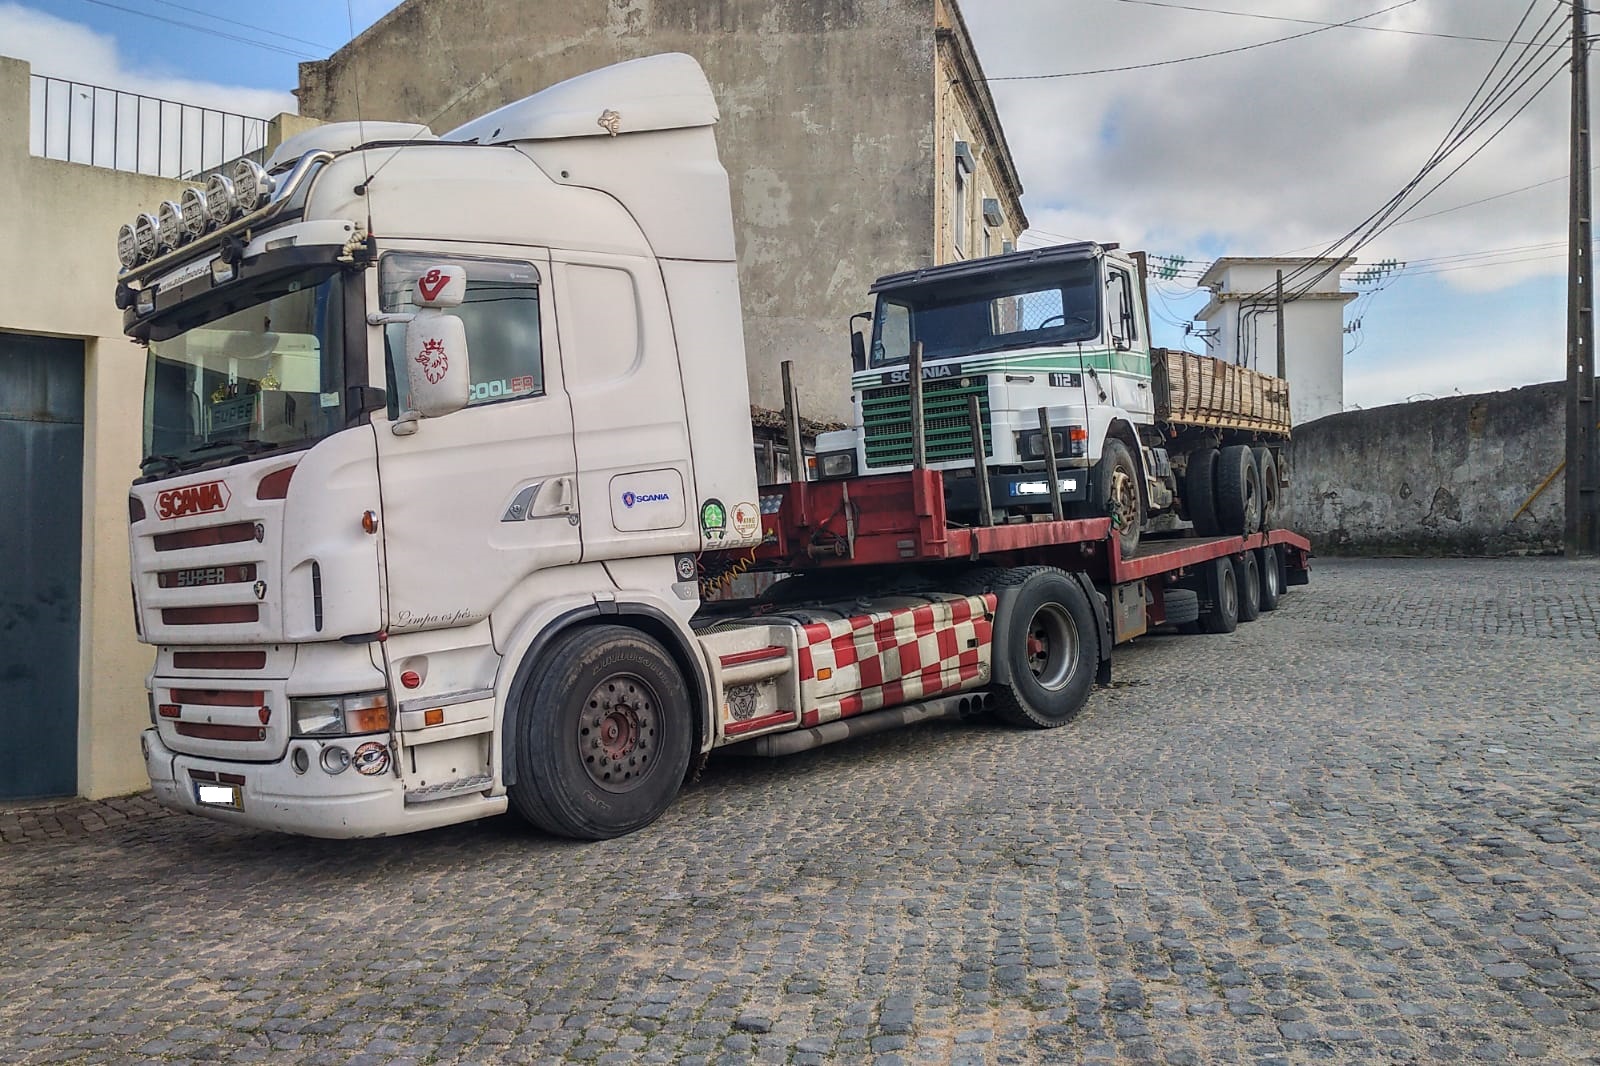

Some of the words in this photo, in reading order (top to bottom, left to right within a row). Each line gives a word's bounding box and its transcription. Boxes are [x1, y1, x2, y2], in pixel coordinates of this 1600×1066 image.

[890, 365, 952, 383] SCNIA
[1053, 373, 1071, 387] 112
[159, 483, 225, 518] SCANIA
[636, 493, 669, 502] SCANIA
[704, 538, 761, 550] SUPER
[178, 567, 225, 586] SUPER
[391, 610, 438, 628] Limpa
